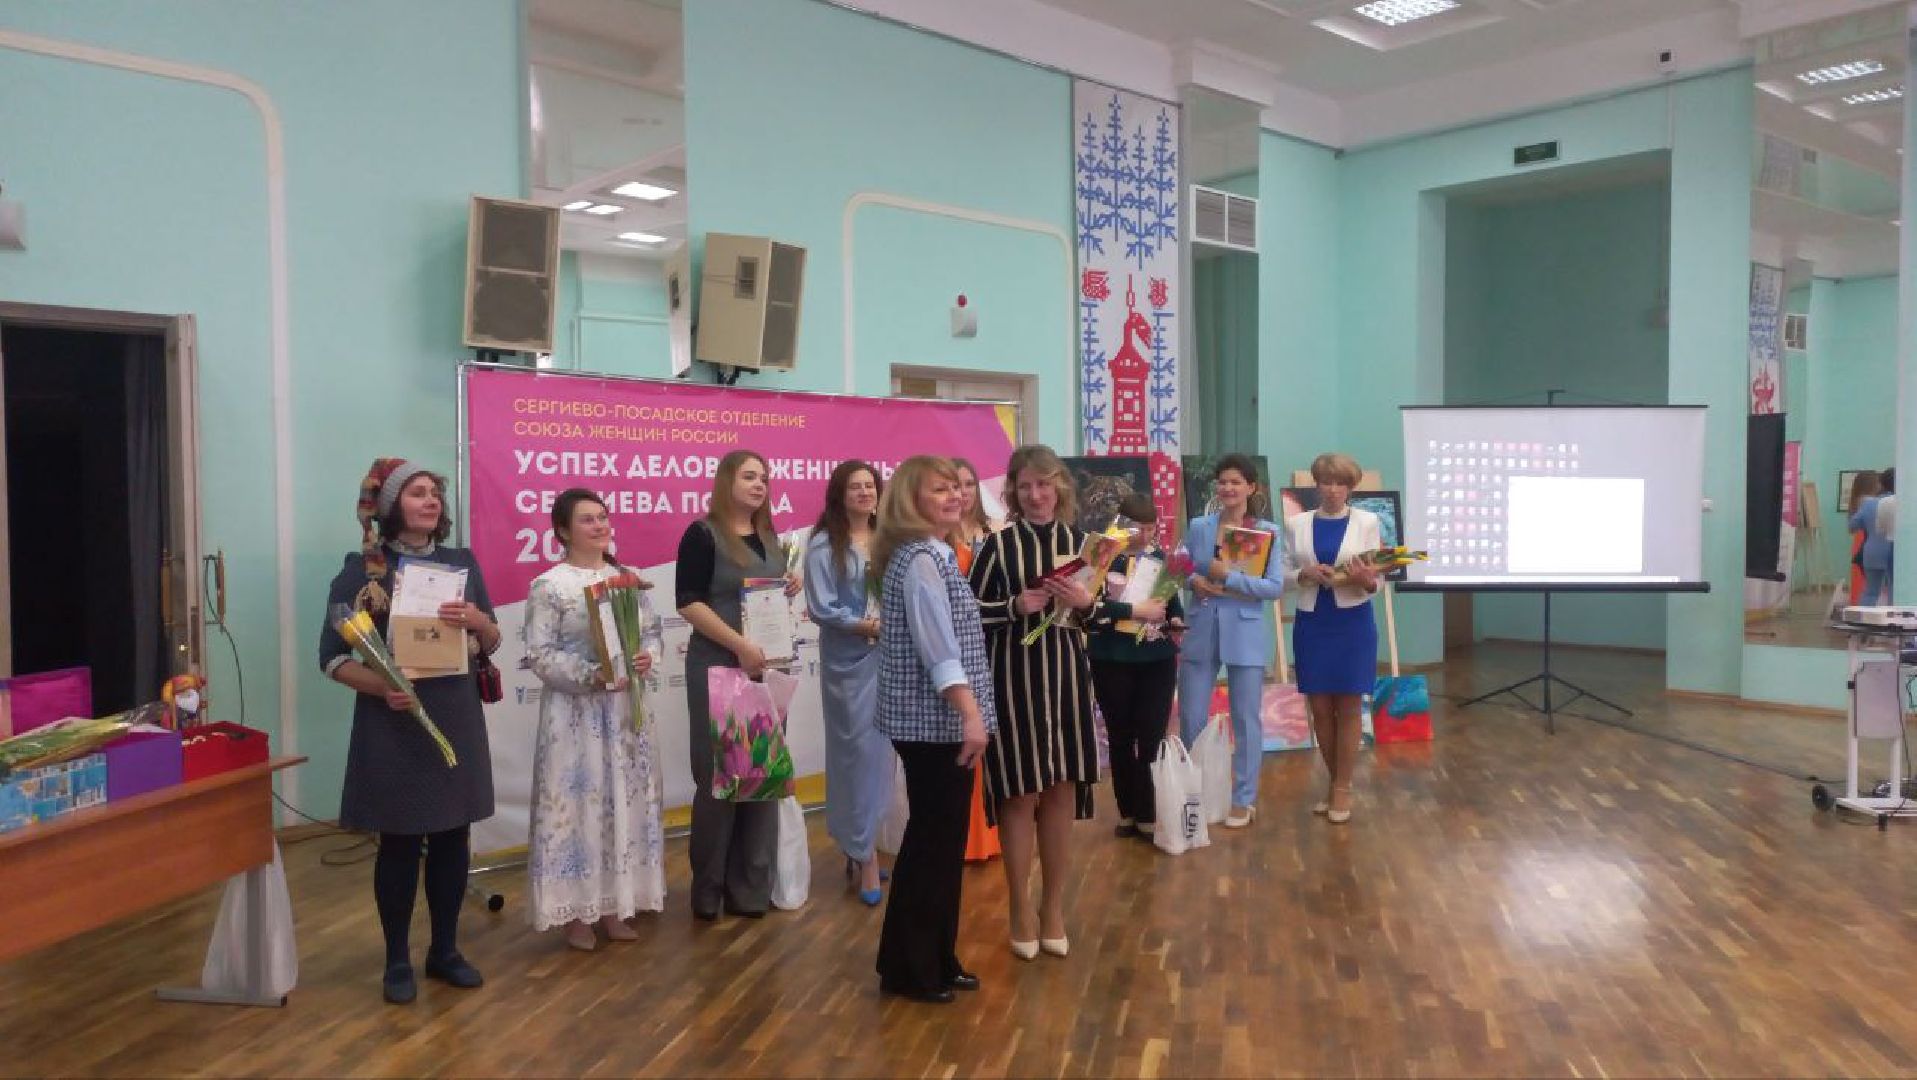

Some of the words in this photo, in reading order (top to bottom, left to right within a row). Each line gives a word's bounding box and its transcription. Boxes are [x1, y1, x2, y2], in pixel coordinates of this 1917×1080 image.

[514, 399, 720, 423] СЕРГИЕВО-ПОСАДСКОЕ
[721, 411, 806, 429] ОТДЕЛЕНИЕ
[514, 422, 583, 438] СОЮЗА
[589, 424, 667, 442] ЖЕНЩИН
[671, 429, 738, 444] РОССИИ
[514, 450, 620, 477] УСПЕХ
[626, 455, 719, 480] ДЕЛОВ
[515, 490, 673, 514] СЕИЕВА
